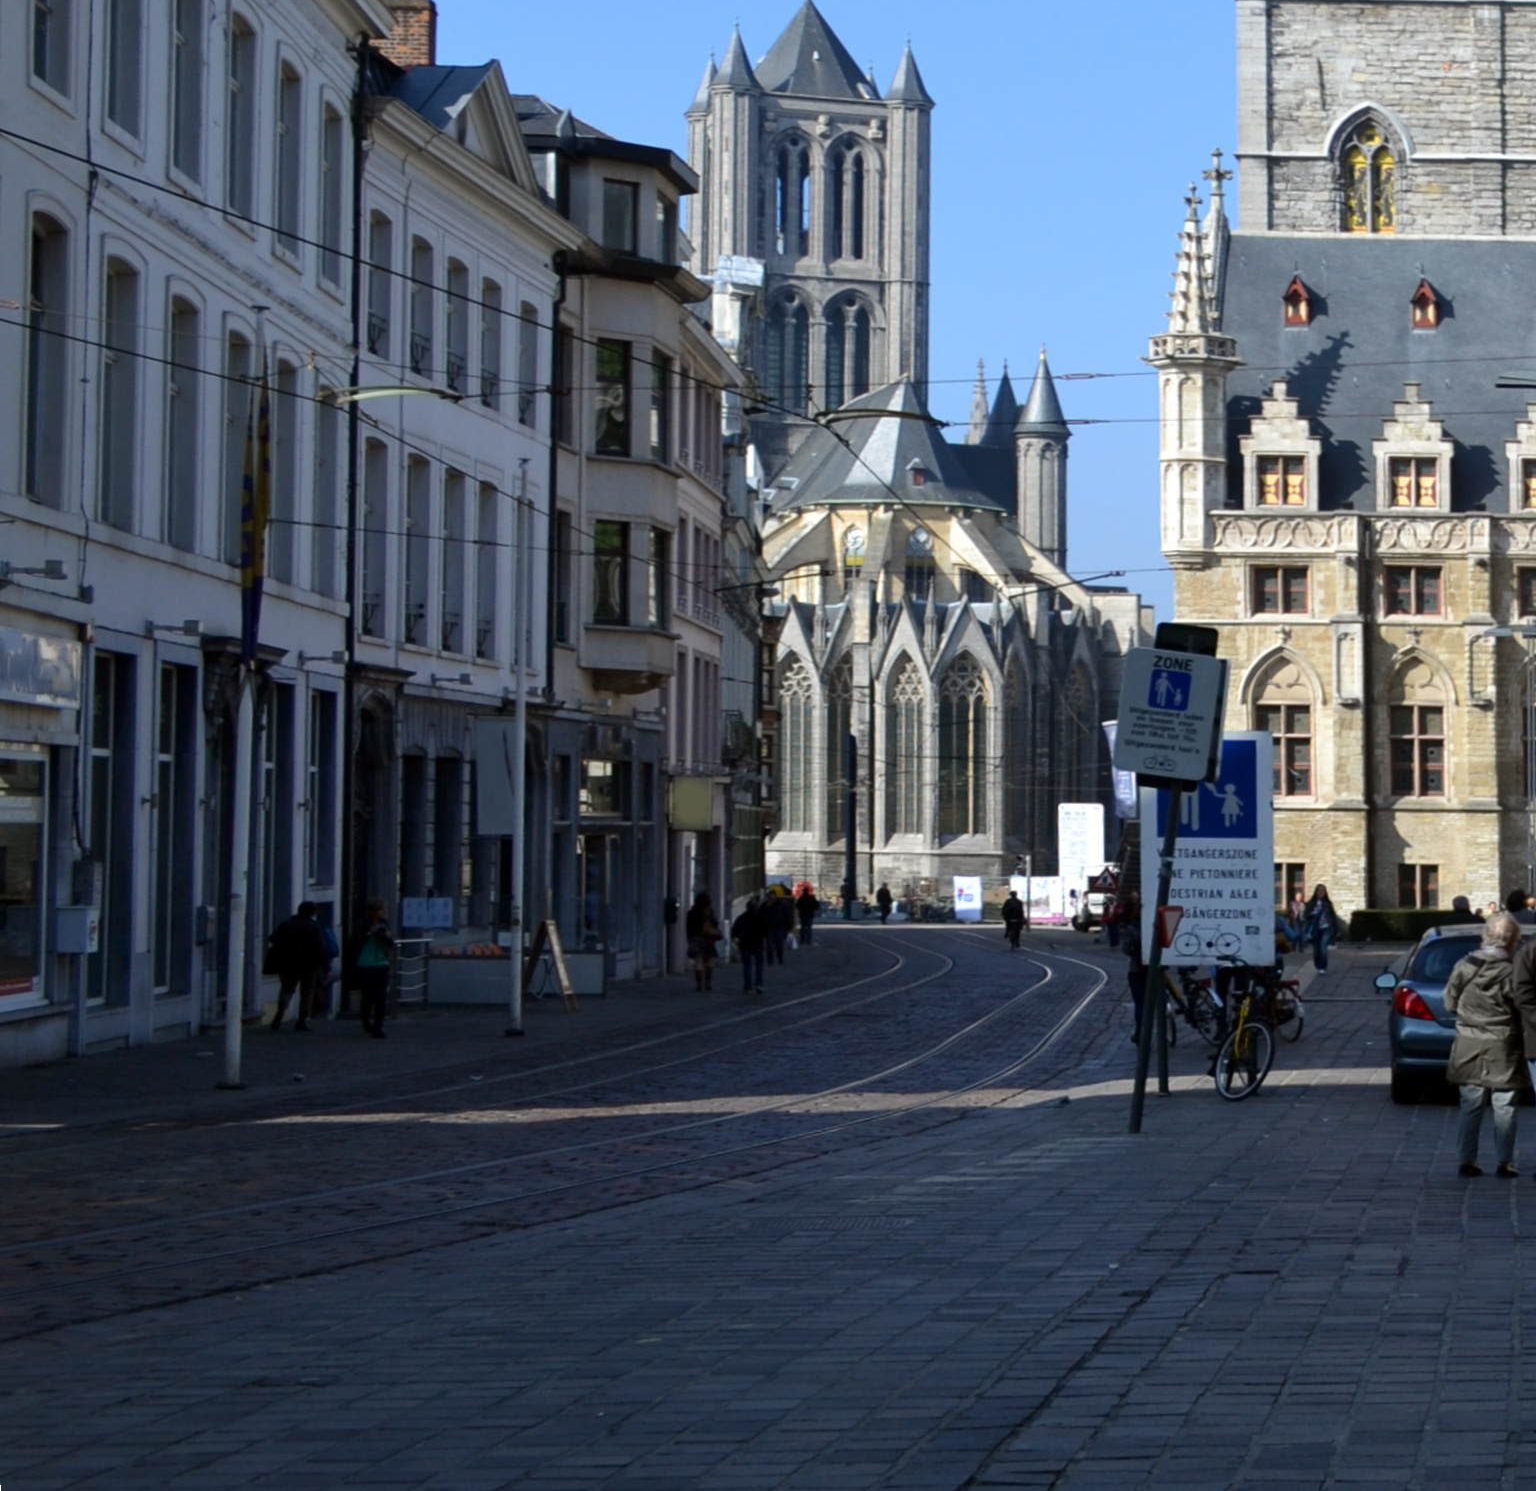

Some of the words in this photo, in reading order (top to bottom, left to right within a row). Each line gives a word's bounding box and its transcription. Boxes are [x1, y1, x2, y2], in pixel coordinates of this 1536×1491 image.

[1153, 655, 1194, 671] ZONE
[1157, 848, 1258, 859] VTGANGERSZONE
[1190, 869, 1258, 879] PIETONNIERE
[1171, 888, 1223, 899] DESTRIAN
[1184, 906, 1253, 919] GÄNGERZONE
